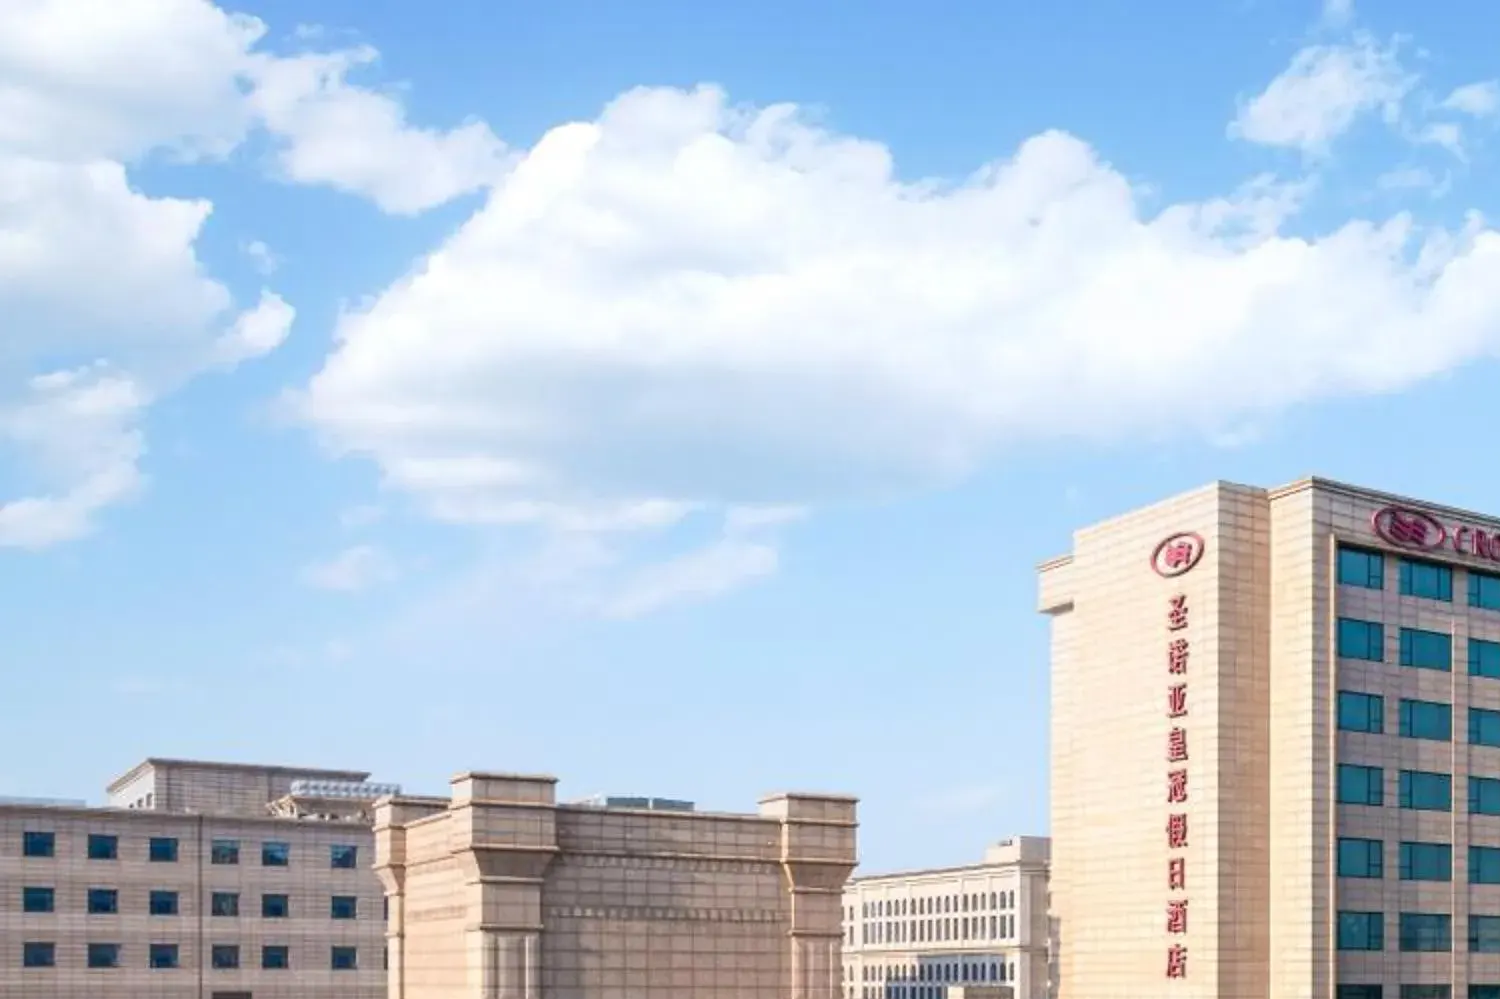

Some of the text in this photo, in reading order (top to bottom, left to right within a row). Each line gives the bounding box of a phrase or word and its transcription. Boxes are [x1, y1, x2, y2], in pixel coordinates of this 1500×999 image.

[1167, 593, 1189, 978] 圣诺亚皇冠假日酒店
